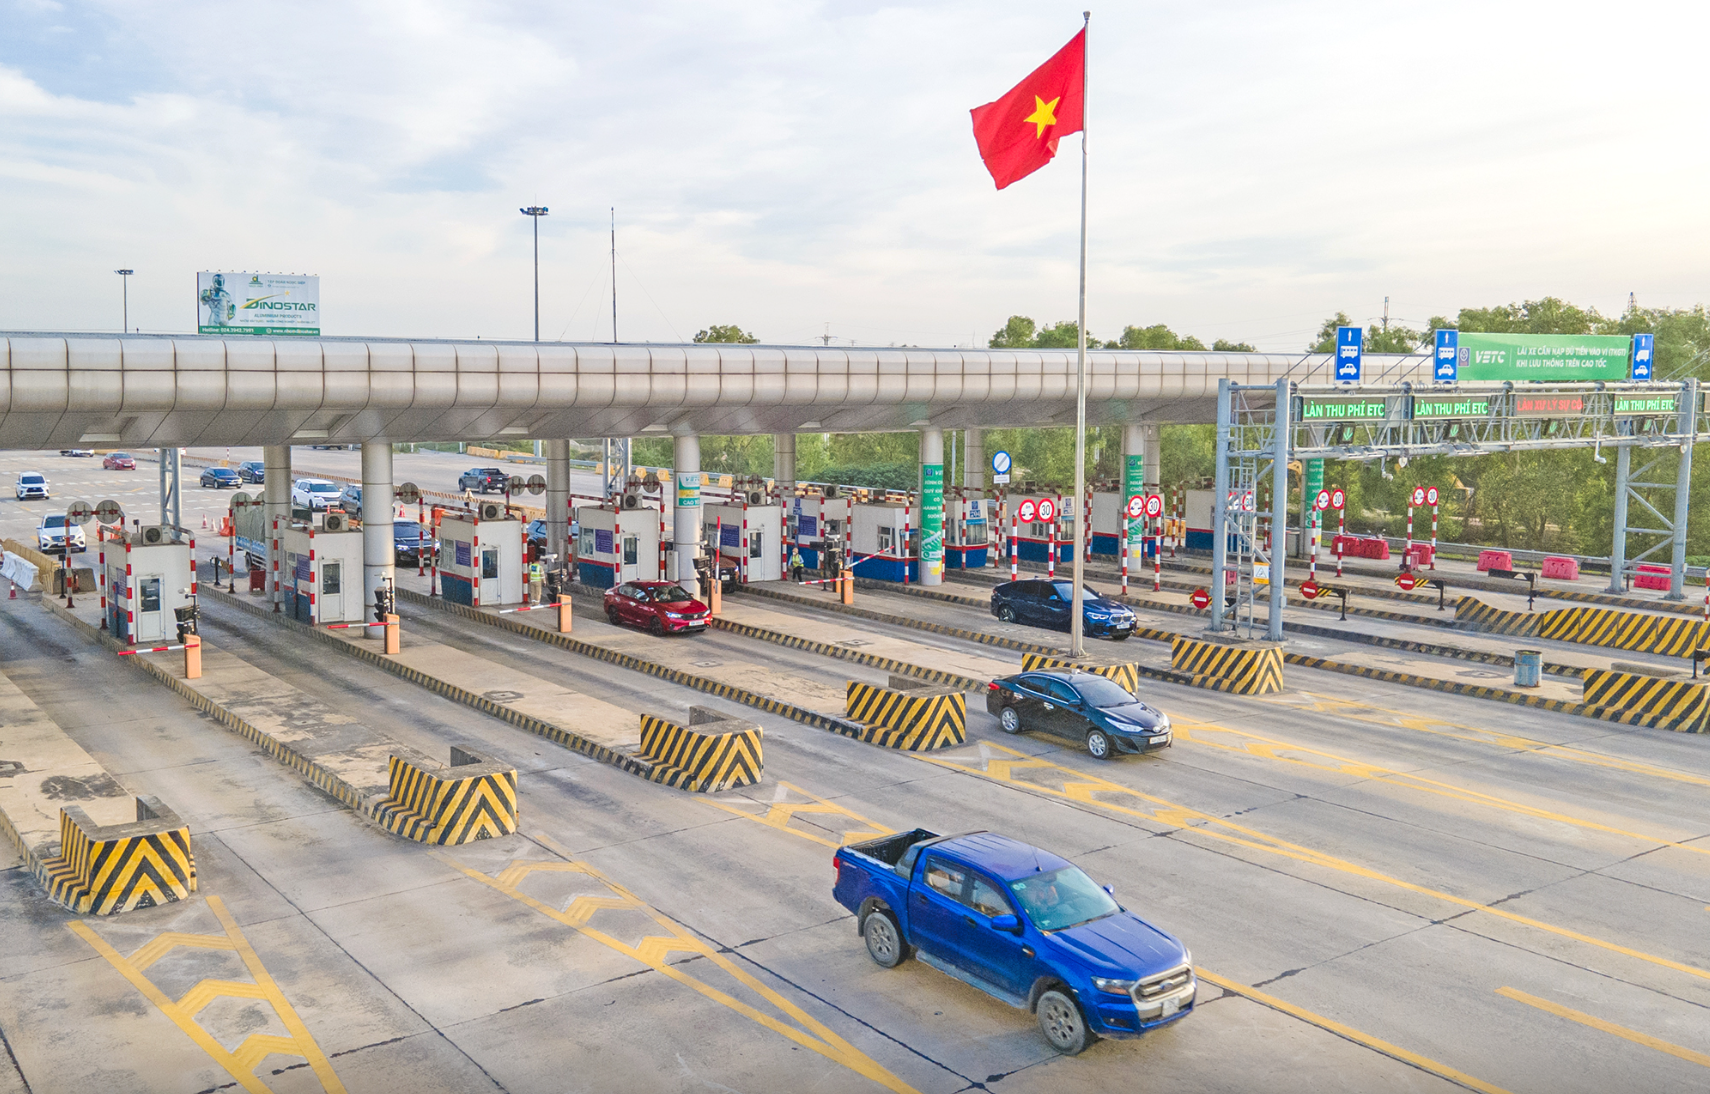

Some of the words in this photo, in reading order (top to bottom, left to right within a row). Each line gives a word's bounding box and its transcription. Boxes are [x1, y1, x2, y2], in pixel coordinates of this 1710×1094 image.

[244, 298, 316, 311] DINOSTAR
[1476, 350, 1506, 364] VETC
[1517, 346, 1528, 356] LÁI
[1528, 347, 1536, 356] XE
[1538, 345, 1551, 356] CẦN
[1552, 347, 1564, 358] NẠP
[1588, 347, 1600, 356] VÀO
[1516, 359, 1527, 367] KHI
[1529, 359, 1542, 367] LƯU
[1543, 358, 1564, 367] THÔNG
[1566, 358, 1580, 367] TRÊN
[1595, 358, 1607, 368] TỐC
[1304, 400, 1323, 417] LÀN
[1325, 404, 1345, 417] THU
[1347, 400, 1366, 417] PHÍ
[1367, 404, 1385, 416] ETC
[1415, 399, 1432, 415] LÀN
[1434, 403, 1452, 415] THU
[1454, 399, 1470, 415] PHÍ
[1472, 402, 1488, 414] ETC
[1517, 398, 1533, 411] LÀN
[1547, 398, 1557, 410] LÝ
[1558, 399, 1570, 411] SỰ
[1615, 396, 1629, 411] LÀN
[1630, 400, 1645, 410] THU
[1647, 396, 1660, 410] PHÍ
[1661, 400, 1674, 410] ETC
[1041, 505, 1050, 516] 30
[1149, 501, 1158, 512] 30
